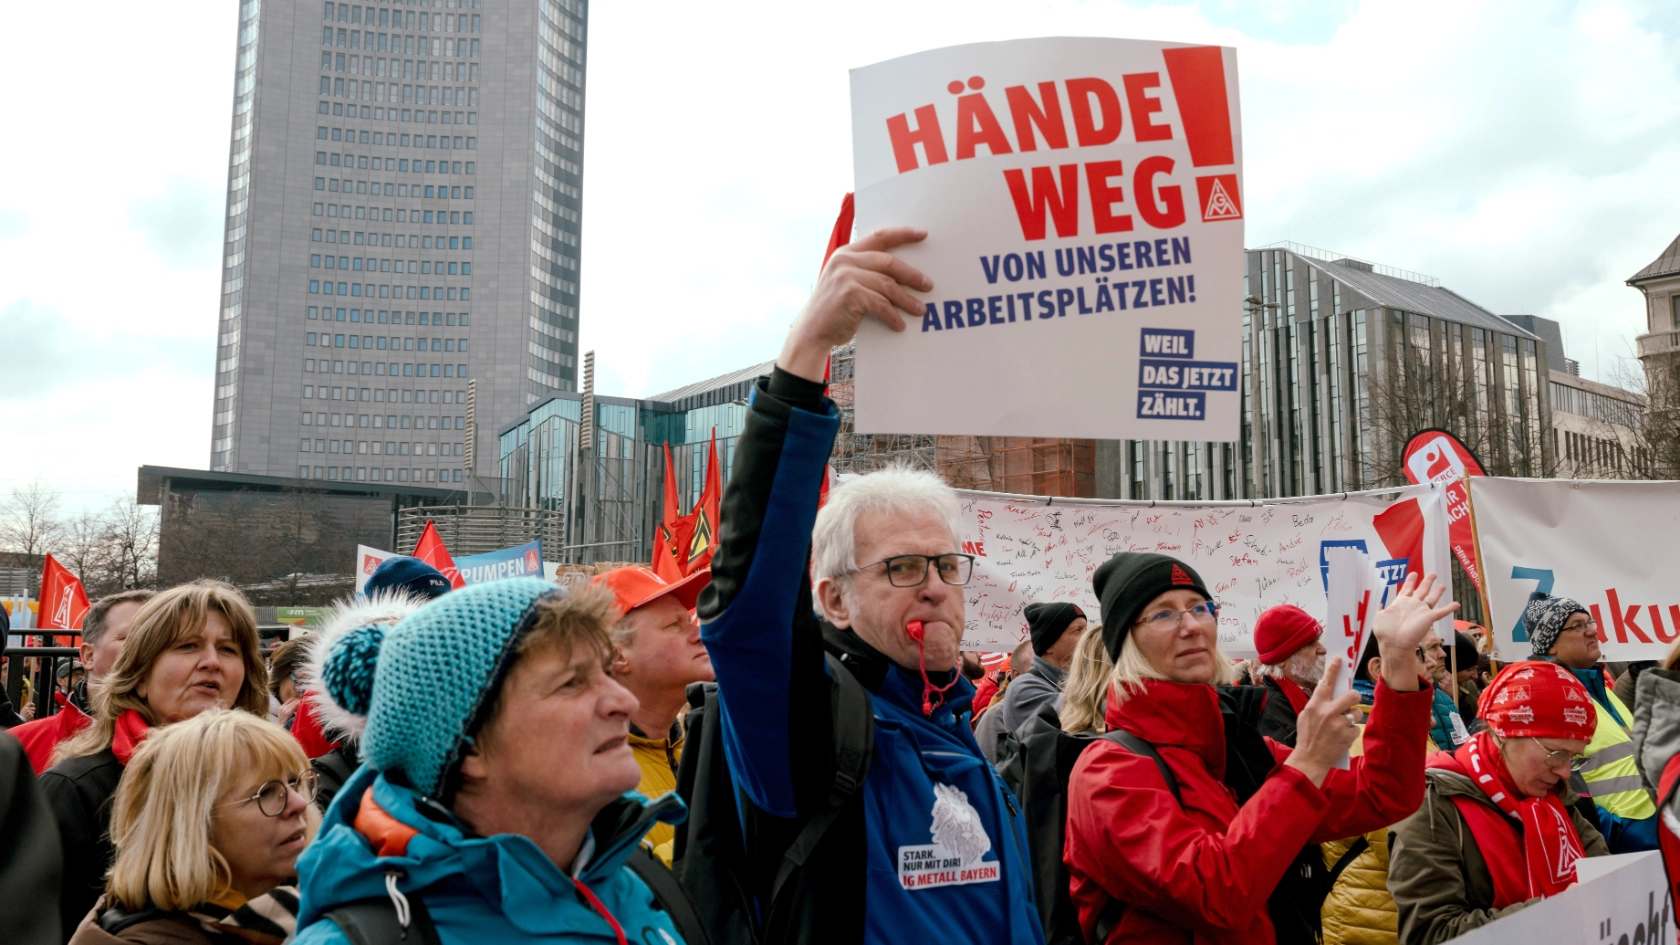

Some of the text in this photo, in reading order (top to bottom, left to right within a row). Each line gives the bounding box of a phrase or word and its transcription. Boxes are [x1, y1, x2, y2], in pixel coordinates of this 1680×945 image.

[980, 236, 1192, 284] VON UNSEREN
[921, 275, 1197, 332] ARBEITSPLÄTZEN!
[1144, 334, 1188, 355] WEIL
[1143, 365, 1234, 389] DAS JETZT
[1141, 393, 1201, 417] ZÄHLT.
[461, 557, 525, 583] PUMPEN
[429, 579, 445, 587] FILA
[903, 849, 936, 861] STARK.
[903, 857, 961, 872] NUR MIT DIR!
[902, 867, 997, 887] IG METALL BAYERN
